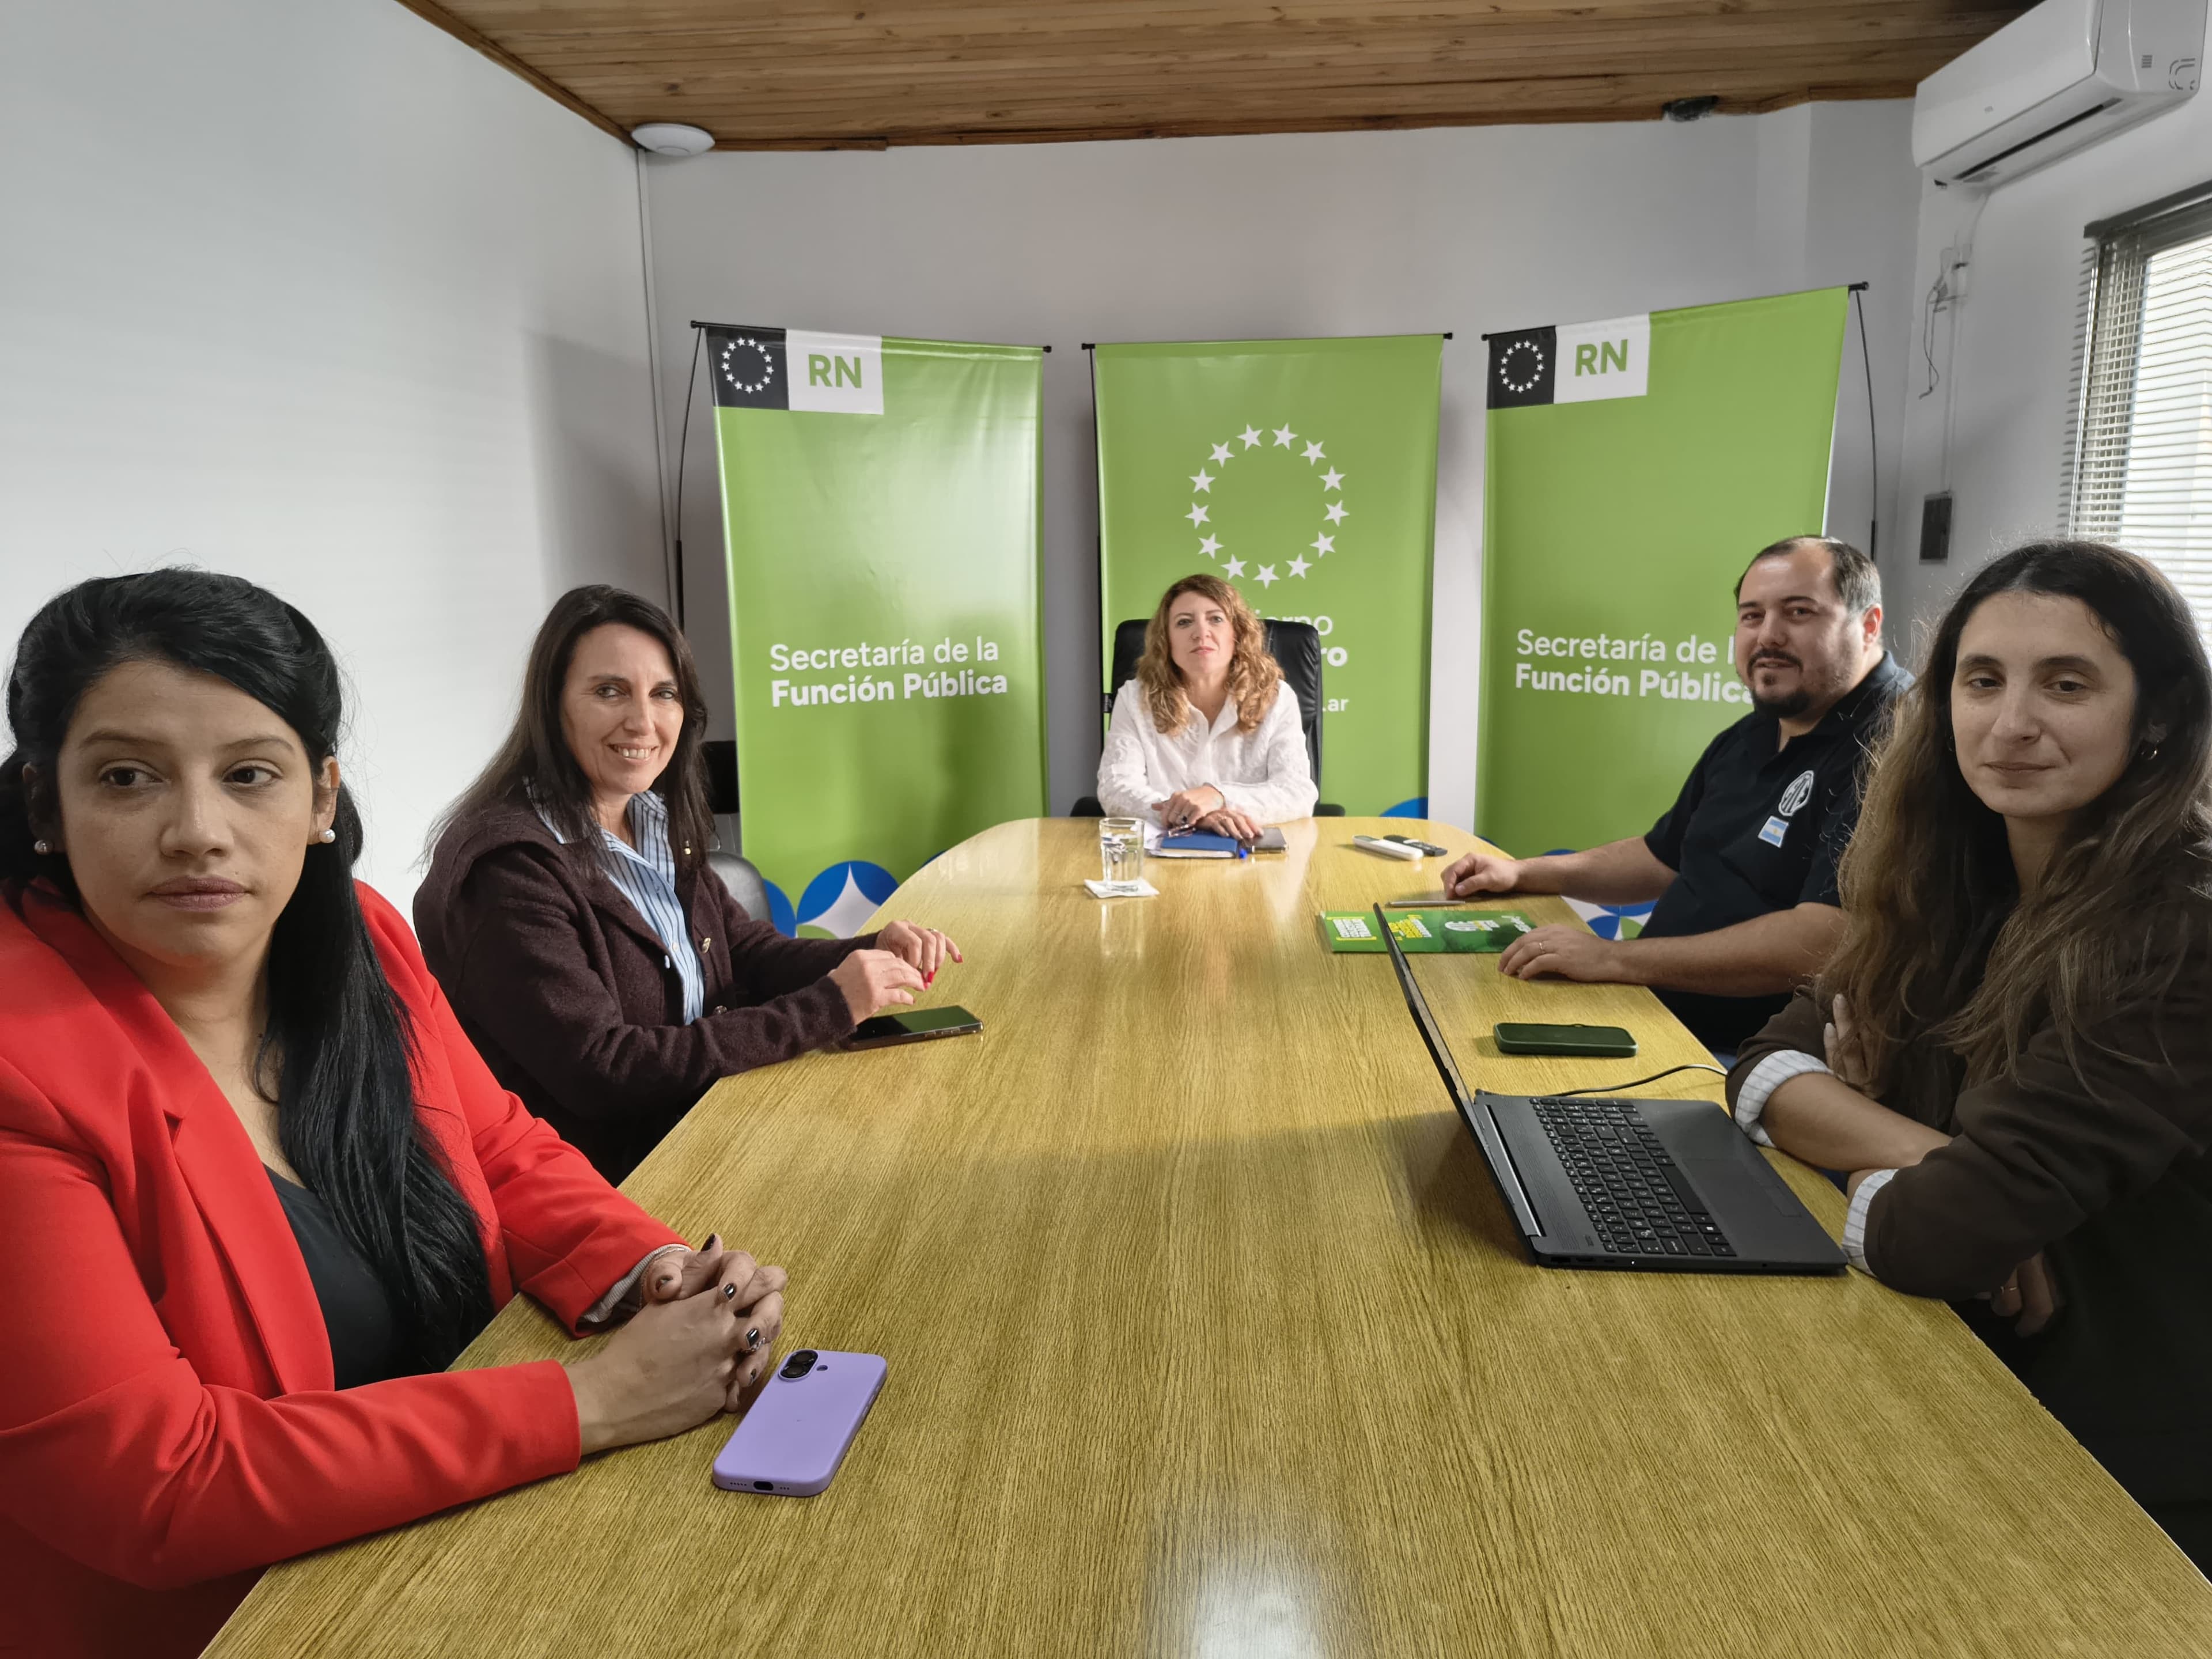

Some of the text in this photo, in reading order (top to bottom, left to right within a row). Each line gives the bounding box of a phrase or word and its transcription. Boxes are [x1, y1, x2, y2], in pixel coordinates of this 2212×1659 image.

[808, 354, 862, 388] RN
[1575, 339, 1628, 377] RN
[770, 635, 999, 672] Secretaría de la
[1516, 628, 1667, 662] Secretaría
[1675, 634, 1718, 665] de
[771, 668, 1008, 708] Función Pública
[1515, 662, 1631, 697] Función
